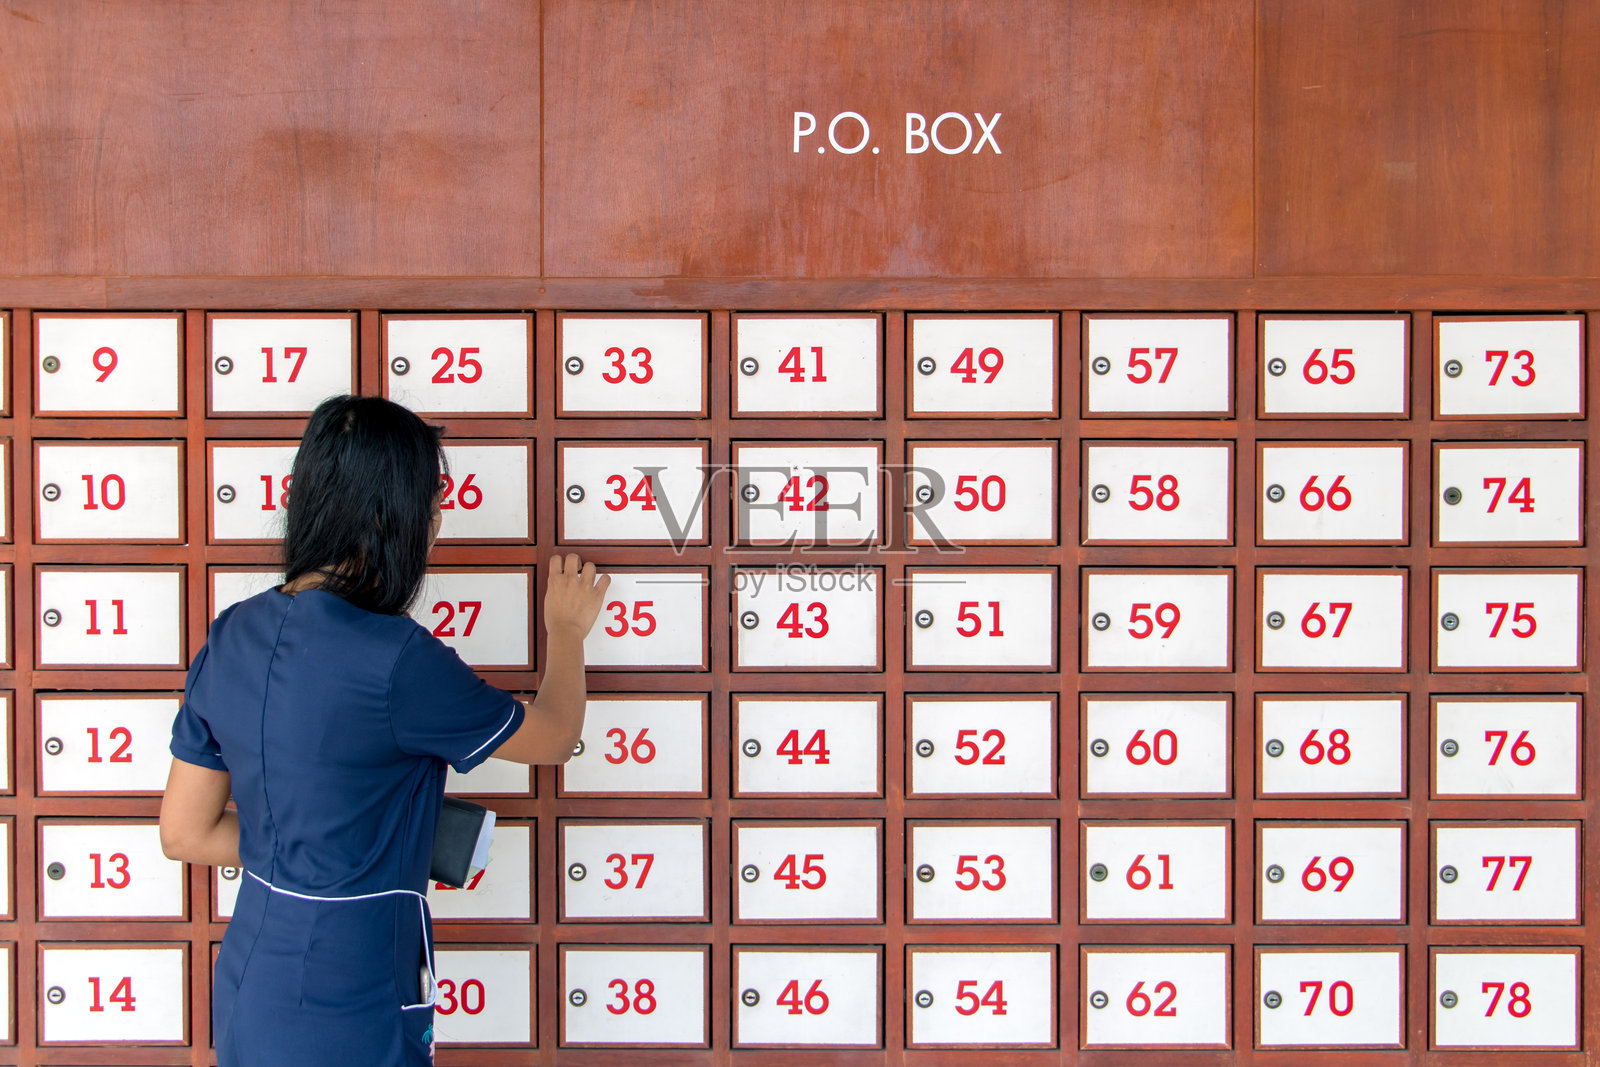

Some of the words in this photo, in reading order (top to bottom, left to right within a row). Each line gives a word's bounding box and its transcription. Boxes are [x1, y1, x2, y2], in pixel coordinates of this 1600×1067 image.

[793, 111, 880, 155] P.O.
[905, 111, 1003, 155] BOX
[92, 346, 118, 383] 9
[261, 347, 307, 383] 17
[431, 347, 483, 384] 25
[602, 346, 654, 385] 33
[778, 346, 827, 383] 41
[950, 347, 1004, 384] 49
[1127, 347, 1178, 384] 57
[1303, 348, 1355, 385] 65
[1486, 349, 1536, 387] 73
[81, 474, 125, 511] 10
[604, 474, 657, 512] 34
[776, 475, 830, 512] 42
[954, 475, 1006, 512] 50
[1129, 474, 1180, 512] 58
[1300, 475, 1352, 512] 66
[1484, 477, 1535, 513] 74
[85, 599, 127, 635] 11
[431, 601, 482, 638] 27
[604, 600, 657, 638] 35
[776, 602, 829, 639] 43
[956, 601, 1004, 638] 51
[1128, 602, 1181, 639] 59
[1302, 602, 1353, 639] 67
[1486, 602, 1537, 639] 75
[86, 727, 132, 763] 12
[605, 727, 656, 765] 36
[776, 729, 830, 765] 44
[955, 729, 1006, 766] 52
[1126, 729, 1178, 766] 60
[1300, 729, 1351, 766] 68
[1485, 730, 1536, 766] 76
[89, 853, 130, 889] 13
[604, 853, 655, 890] 37
[773, 854, 827, 890] 45
[955, 855, 1006, 891] 53
[1127, 855, 1174, 890] 61
[1302, 856, 1354, 892] 69
[1483, 856, 1532, 891] 77
[88, 977, 135, 1012] 14
[434, 979, 485, 1016] 30
[606, 979, 657, 1015] 38
[776, 980, 830, 1015] 46
[956, 981, 1008, 1016] 54
[1127, 982, 1177, 1017] 62
[1301, 981, 1354, 1017] 70
[1482, 982, 1532, 1018] 78
